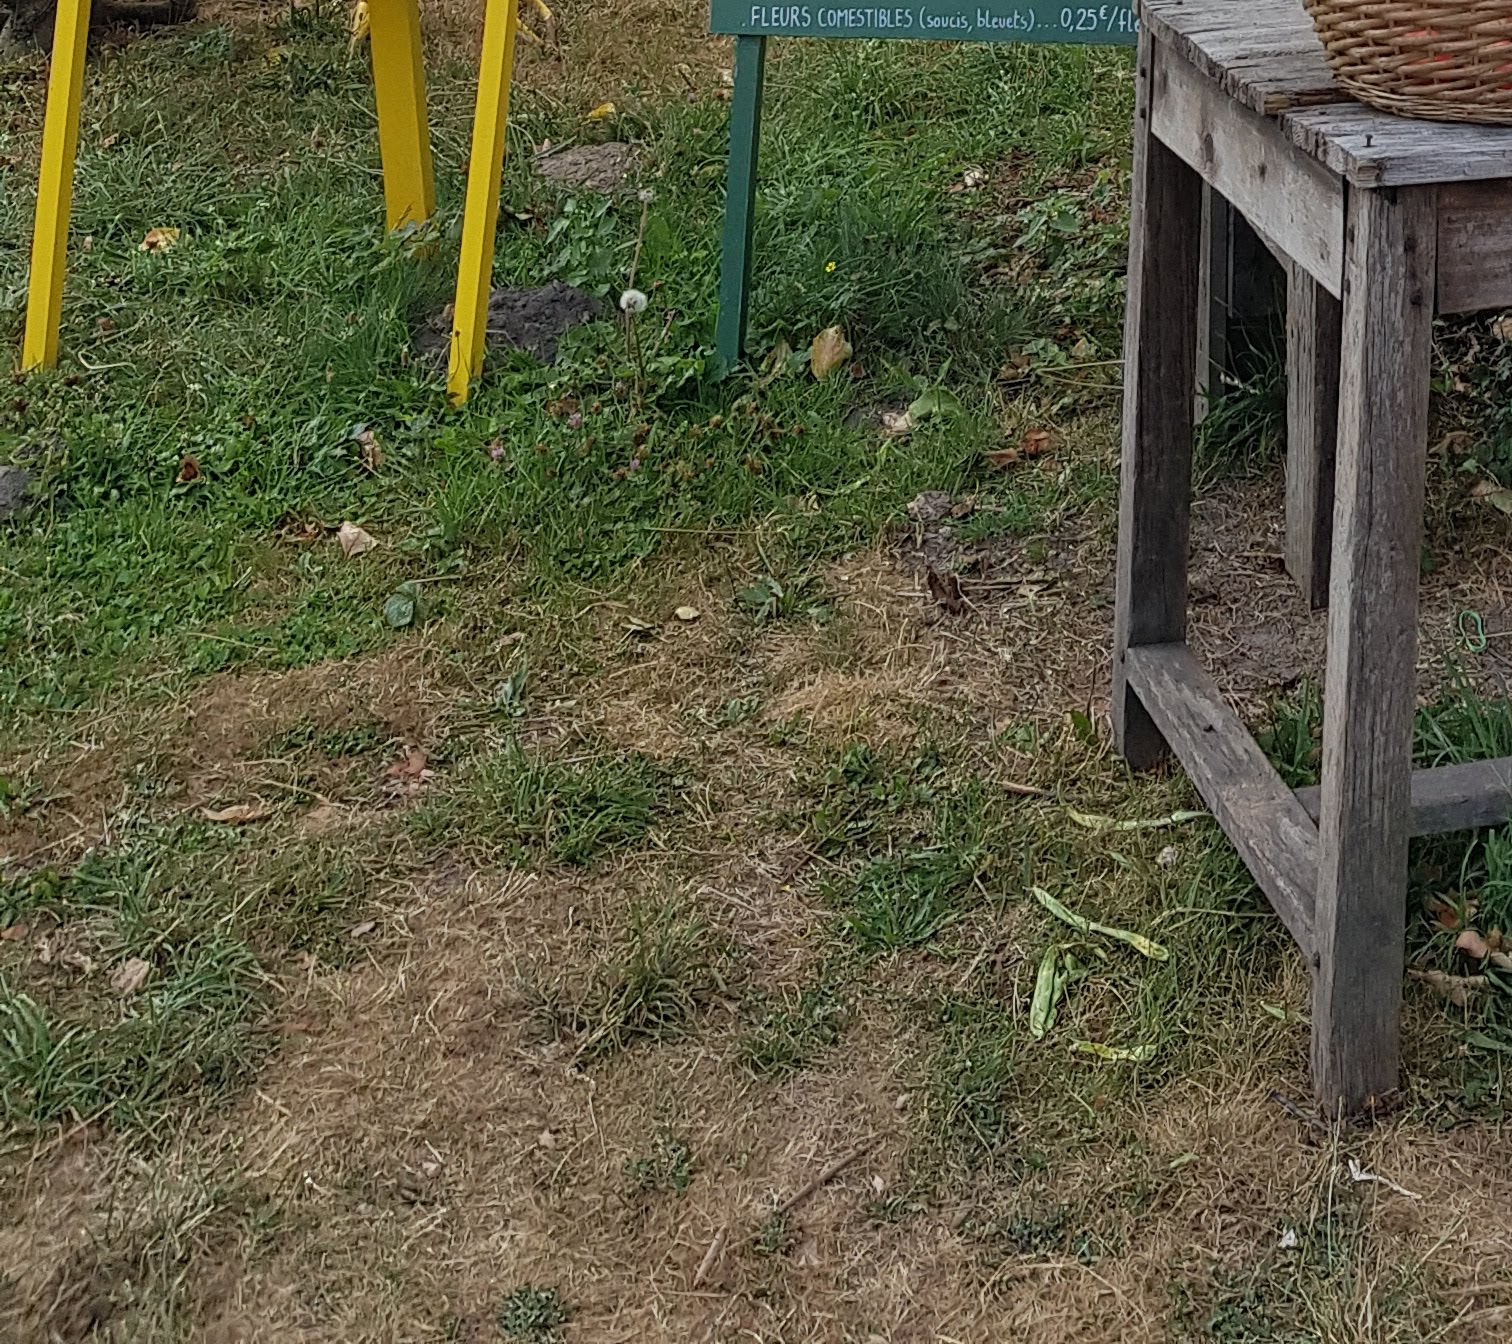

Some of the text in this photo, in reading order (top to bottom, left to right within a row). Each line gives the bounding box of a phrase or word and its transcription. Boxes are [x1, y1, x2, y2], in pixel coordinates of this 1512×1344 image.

[750, 5, 811, 28] FLEURS
[817, 7, 913, 28] COMESTIBLES
[919, 5, 973, 33] (soucis,
[976, 8, 1035, 32] bleuets)
